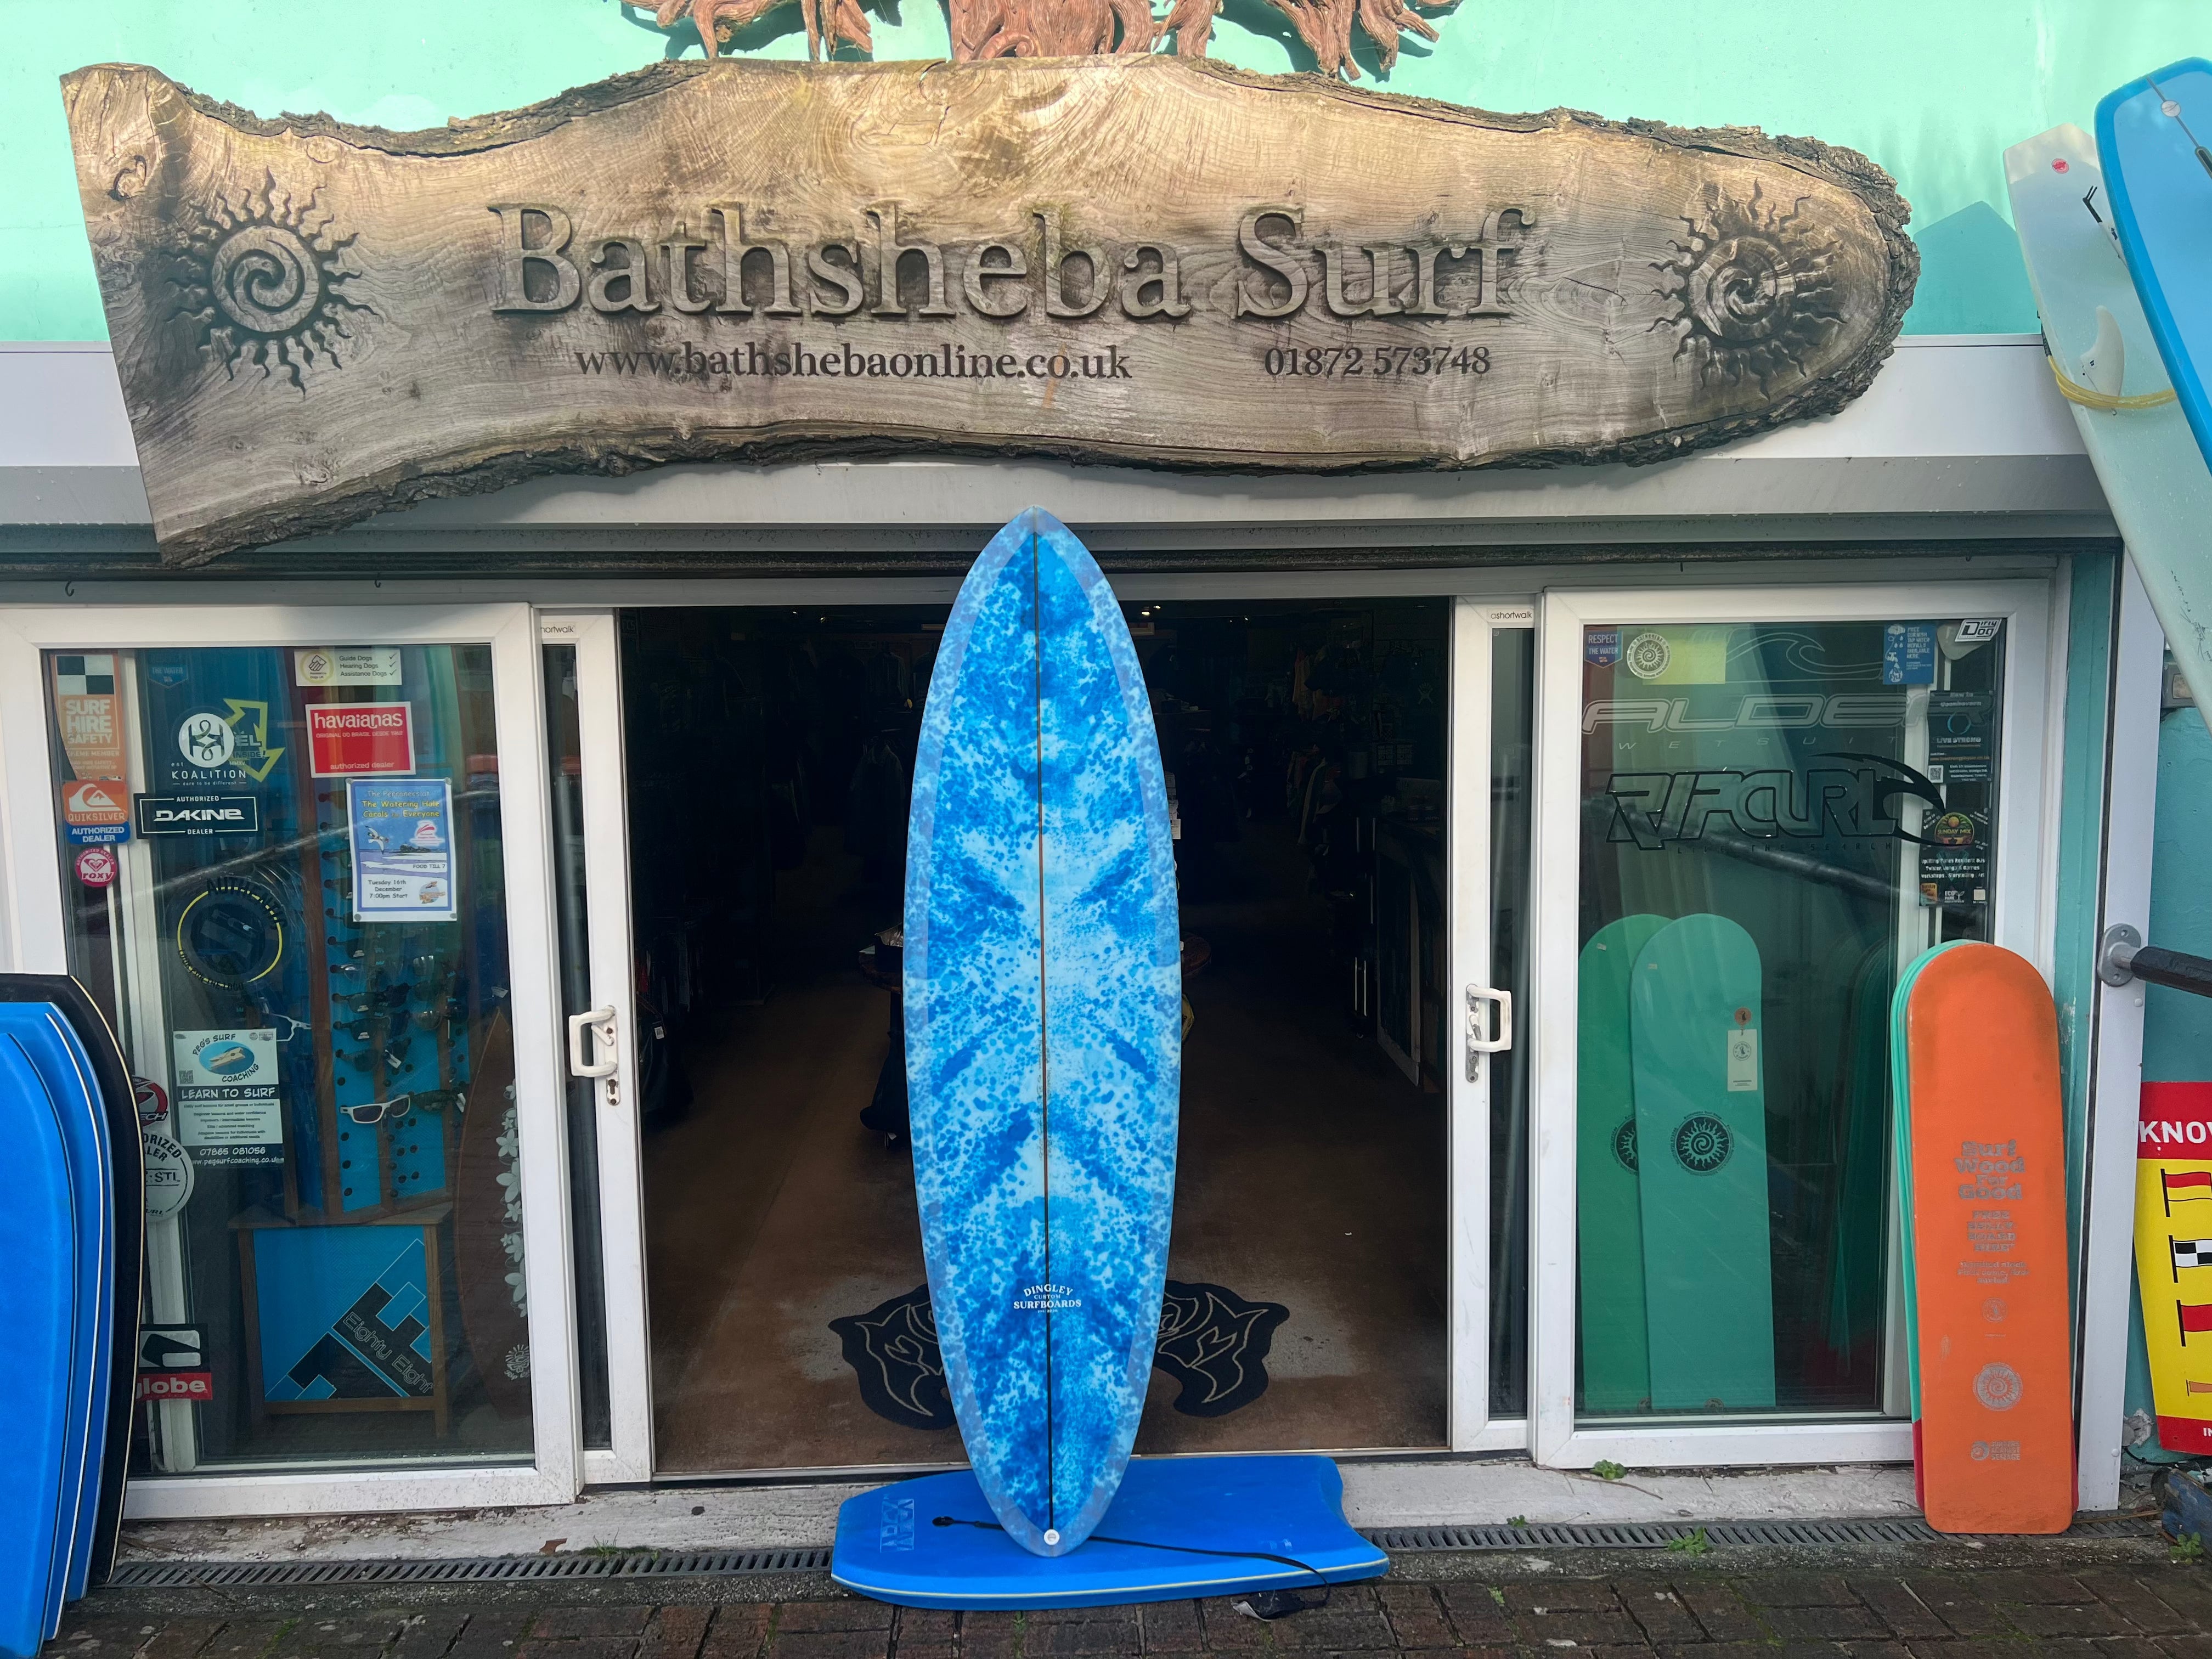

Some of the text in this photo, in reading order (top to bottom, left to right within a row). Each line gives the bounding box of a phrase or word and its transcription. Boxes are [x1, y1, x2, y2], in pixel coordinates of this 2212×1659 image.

[487, 202, 1535, 319] Bathsheba Surf
[574, 341, 1132, 380] www.bathshebaonline.co.uk
[1265, 346, 1491, 376] 01872 573748
[1588, 634, 1618, 644] RESPECT
[66, 699, 110, 715] SURF
[67, 715, 112, 733] HIRE
[314, 712, 403, 729] havaianas
[67, 733, 112, 744] SAFETY
[330, 761, 370, 770] authorized
[172, 770, 246, 780] KOALITION
[381, 800, 419, 809] Watering
[68, 812, 125, 822] QUIKSILVER
[154, 808, 245, 821] DAKINE
[403, 810, 439, 819] Everyone
[71, 826, 125, 836] AUTHORIZED
[82, 834, 115, 843] DEALER
[82, 872, 115, 881] roxy
[193, 1034, 236, 1056] PEG'S SURF
[222, 1063, 259, 1082] COACHING
[182, 1087, 275, 1099] LEARN TO SURF
[143, 1133, 182, 1159] ORIZED
[1961, 1139, 2016, 1156] Surf
[144, 1146, 168, 1163] LER
[1954, 1156, 2025, 1173] Wood
[1976, 1175, 2008, 1186] For
[1959, 1183, 2023, 1200] Good
[1973, 1210, 2011, 1219] FREE
[1967, 1232, 2017, 1241] BOARD
[1024, 1284, 1074, 1297] DINGLEY
[1013, 1299, 1081, 1310] SURFBOARDS
[343, 1311, 434, 1394] Eighty Eight
